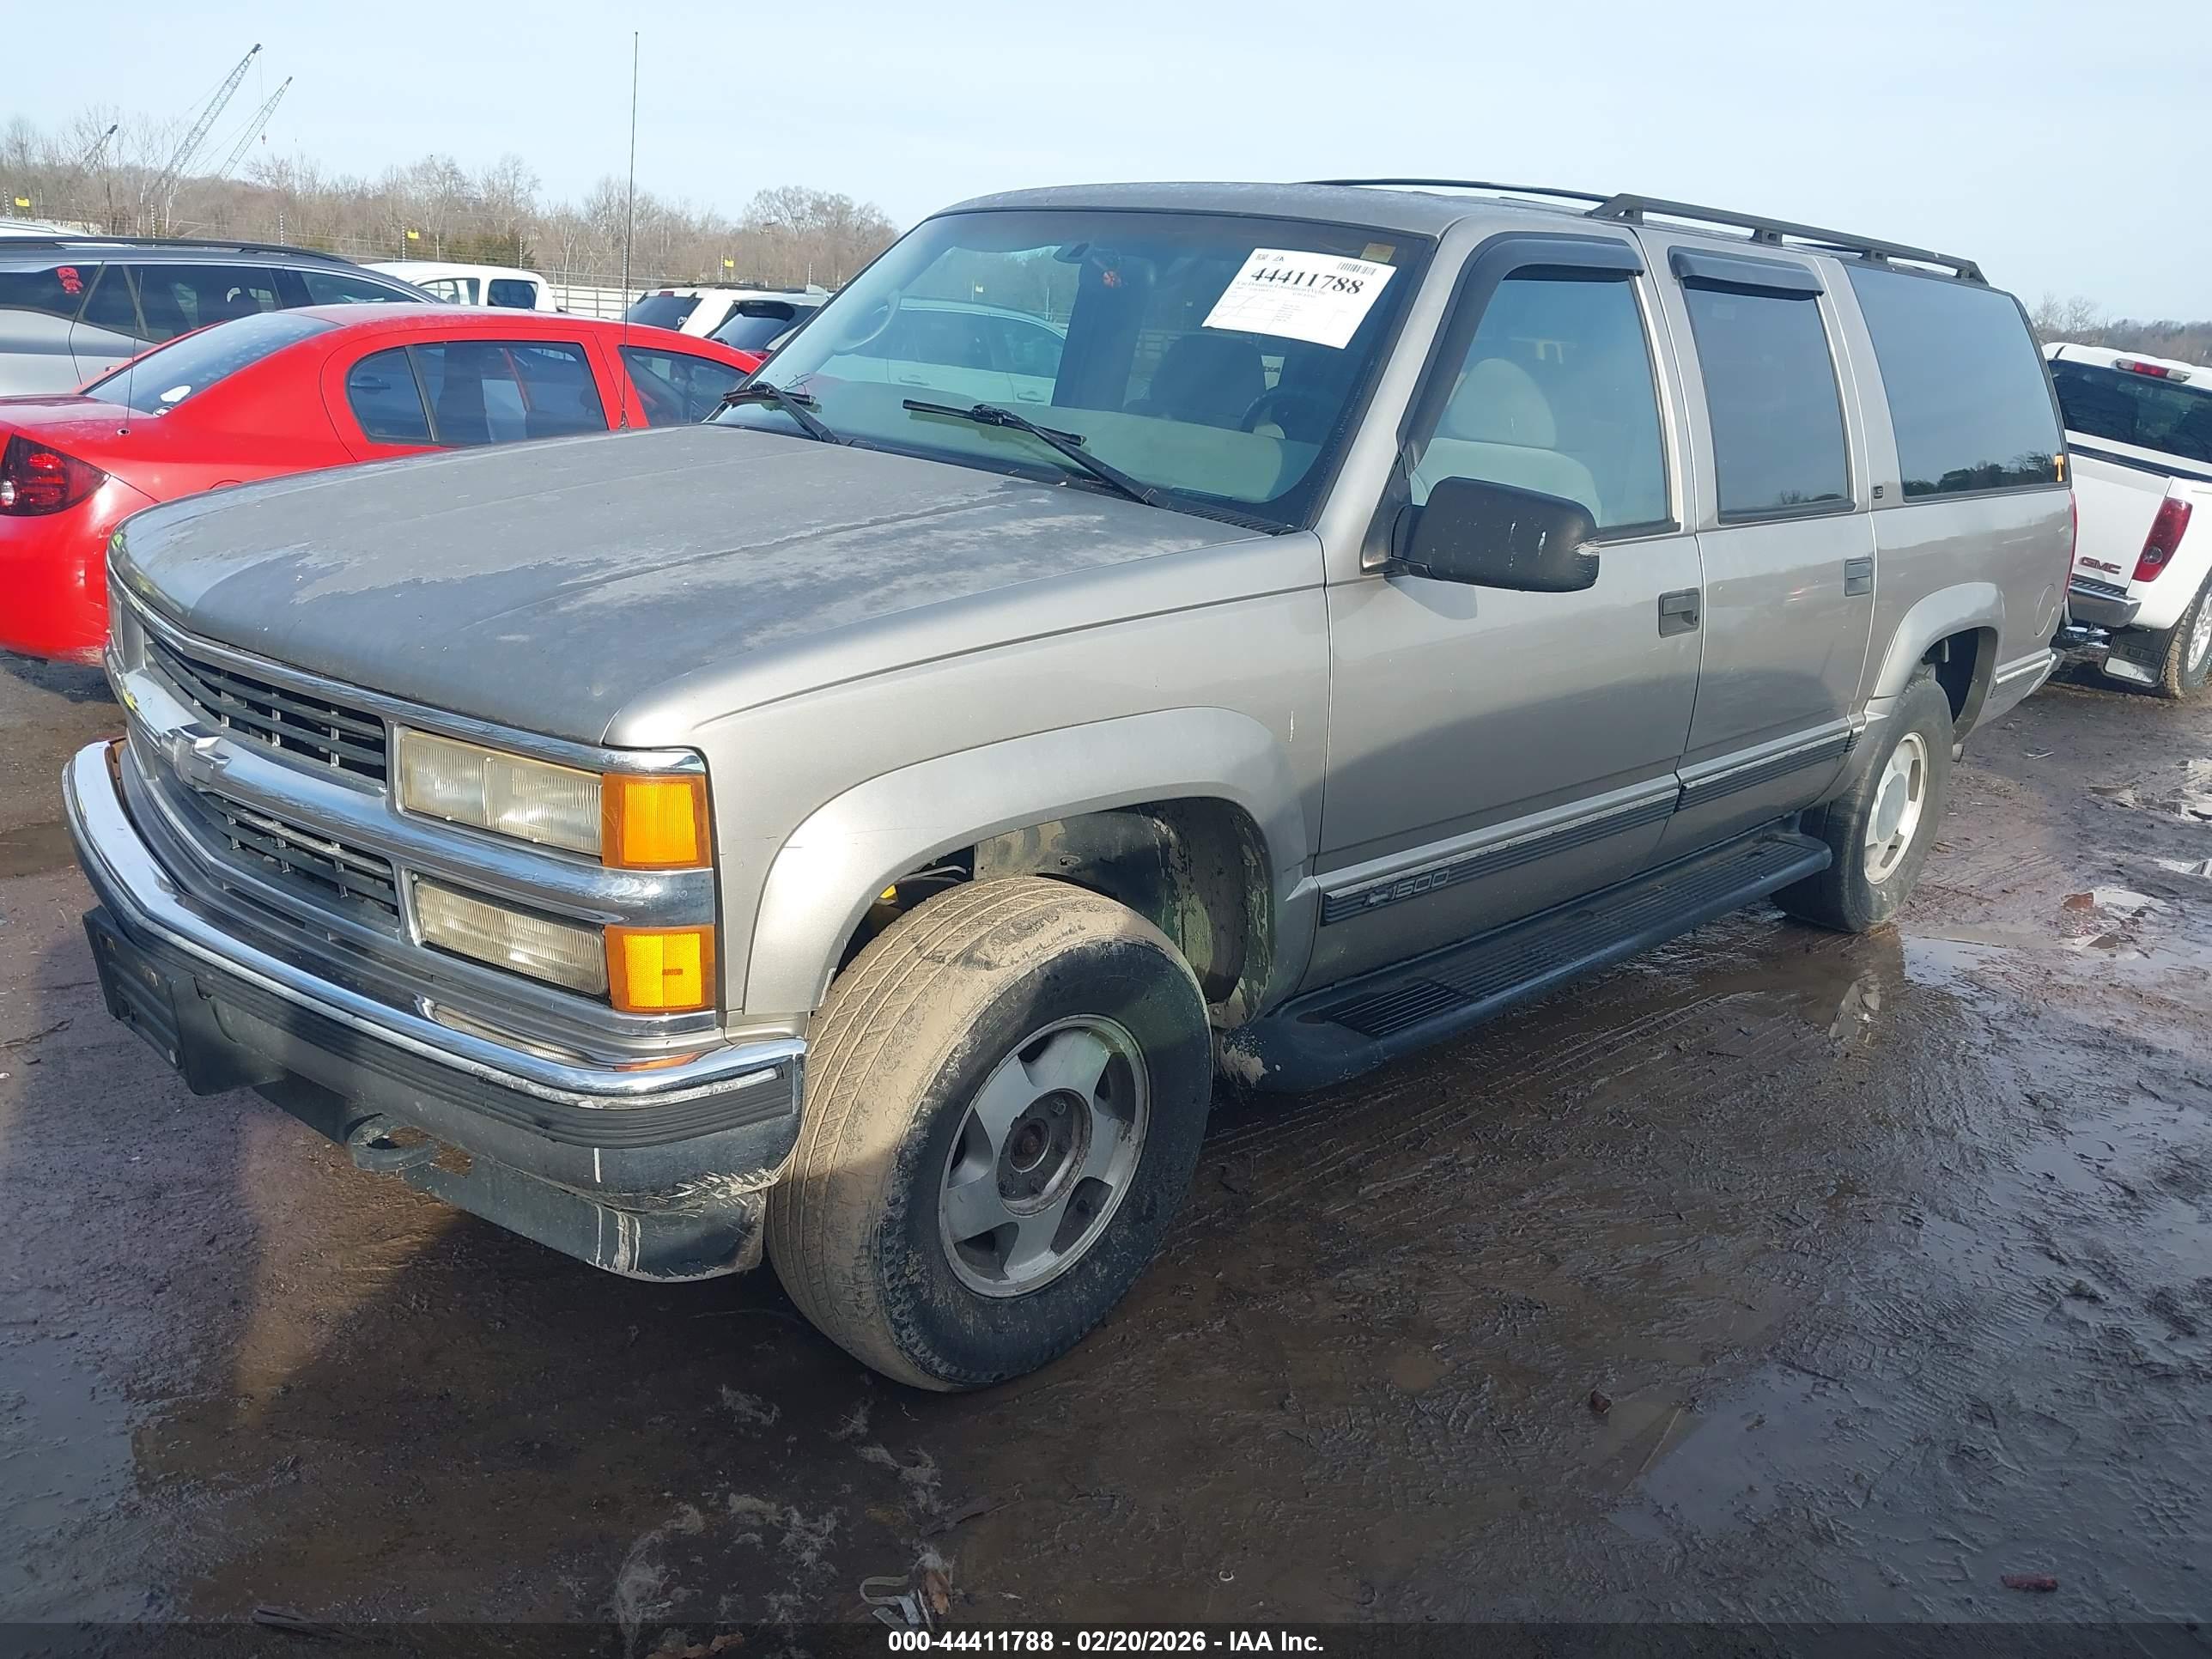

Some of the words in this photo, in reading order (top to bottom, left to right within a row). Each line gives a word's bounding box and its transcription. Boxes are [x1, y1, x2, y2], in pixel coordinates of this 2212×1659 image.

[1251, 267, 1364, 295] 44411788
[2080, 556, 2122, 574] GMC
[1391, 870, 1449, 900] 1500
